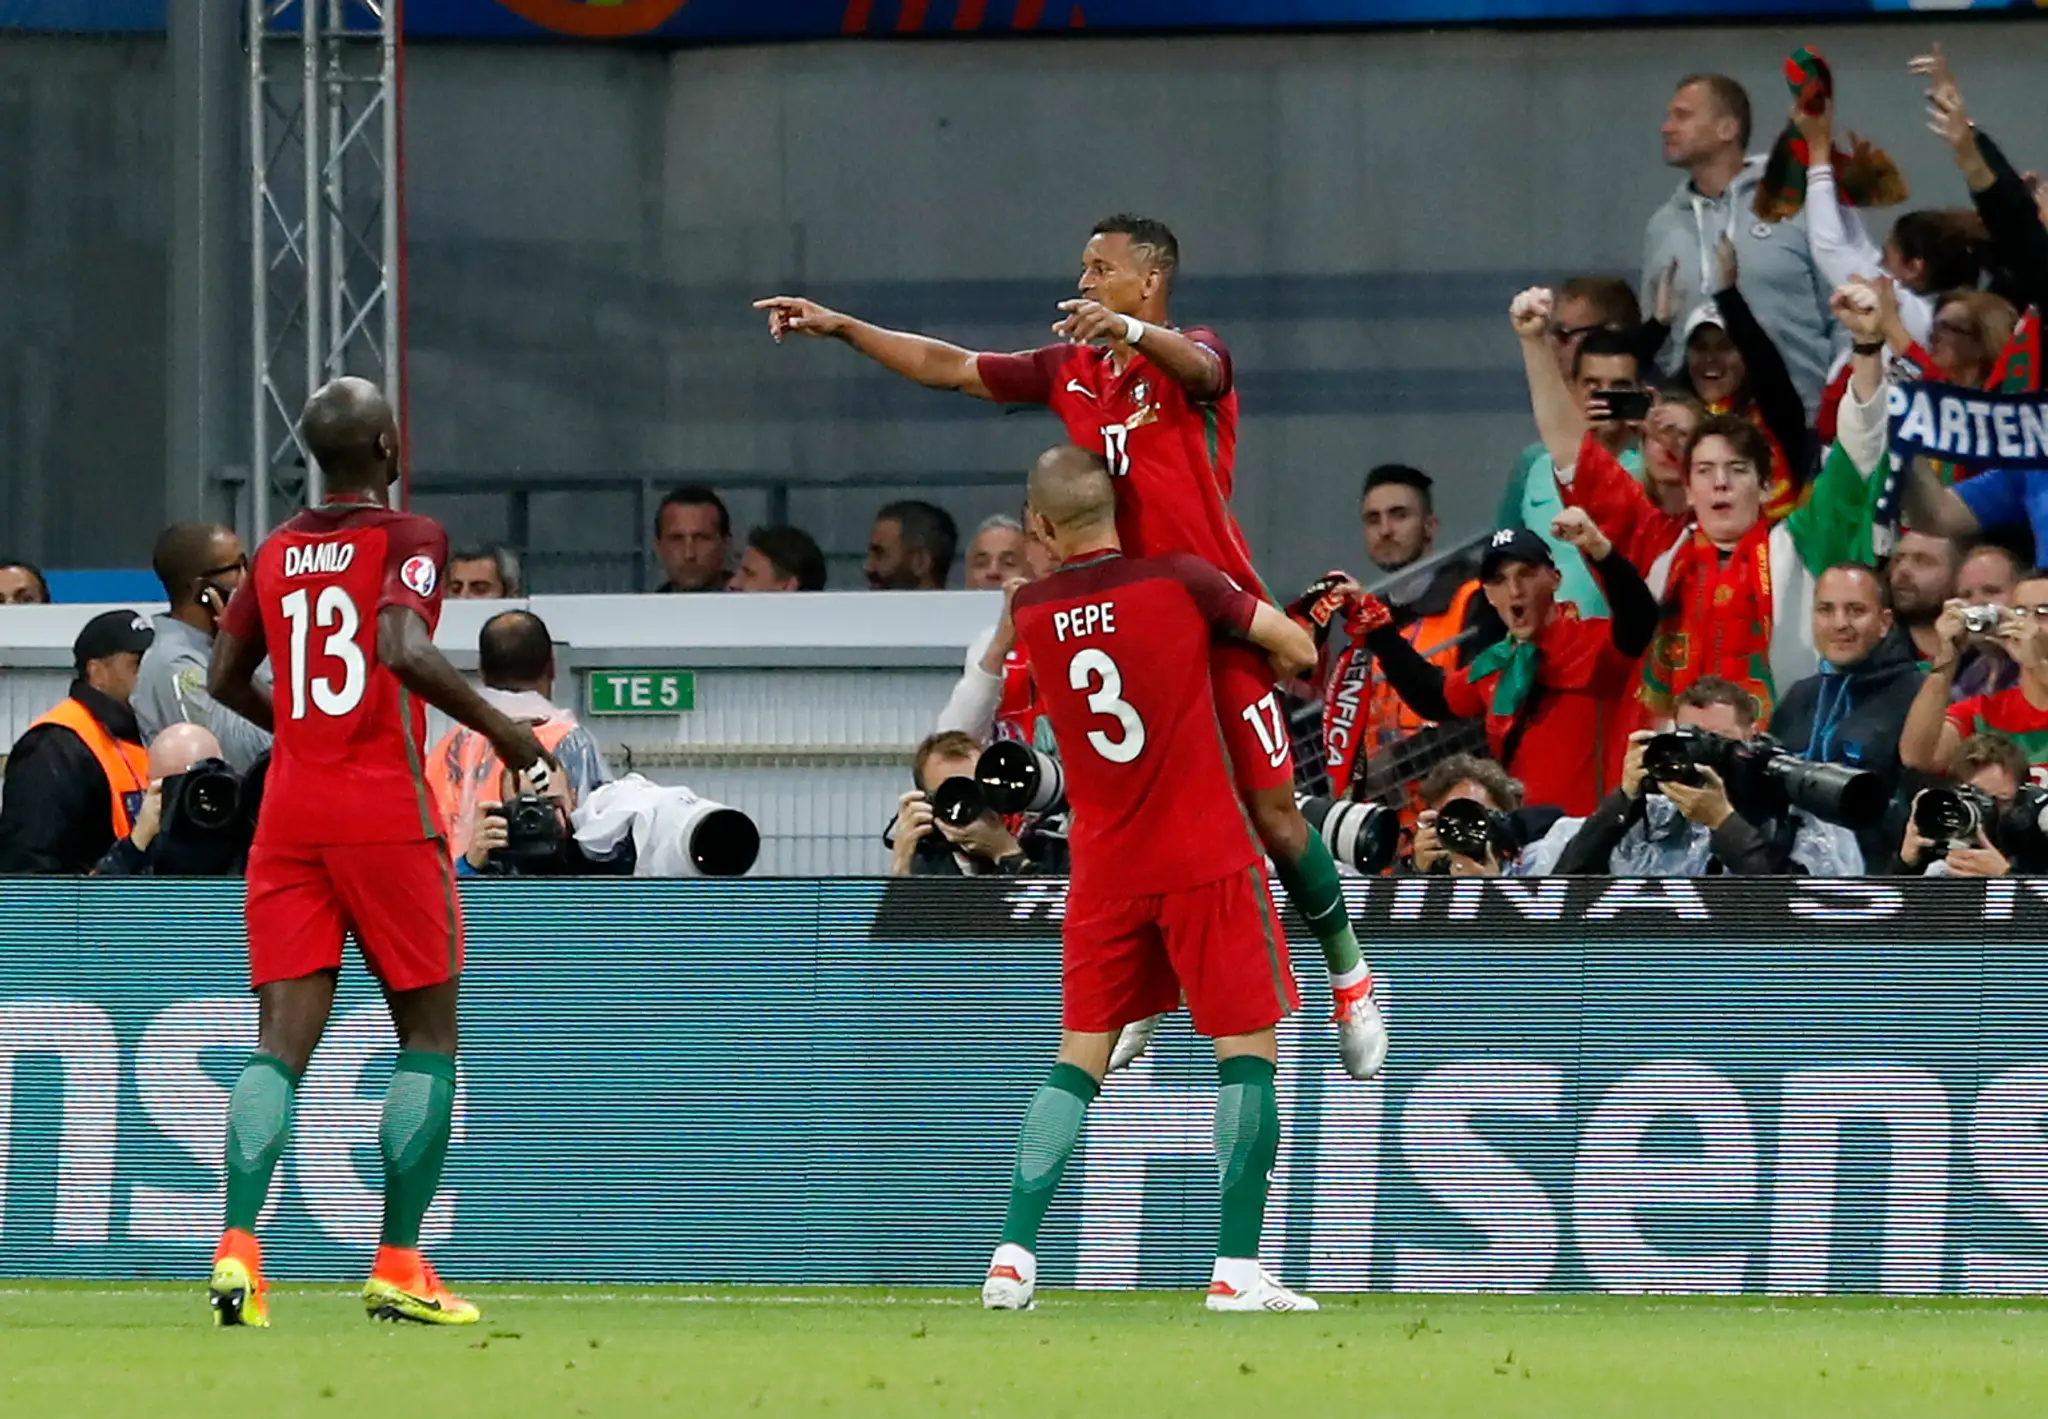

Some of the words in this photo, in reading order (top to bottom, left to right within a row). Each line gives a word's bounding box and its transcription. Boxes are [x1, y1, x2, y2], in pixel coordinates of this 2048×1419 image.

[1887, 384, 2048, 458] PARTEN
[284, 542, 355, 578] DANILO
[281, 585, 367, 720] 13
[1053, 601, 1117, 642] PEPE
[607, 677, 652, 706] TE
[659, 677, 680, 706] 5
[1069, 647, 1146, 763] 3
[1241, 690, 1285, 756] 17
